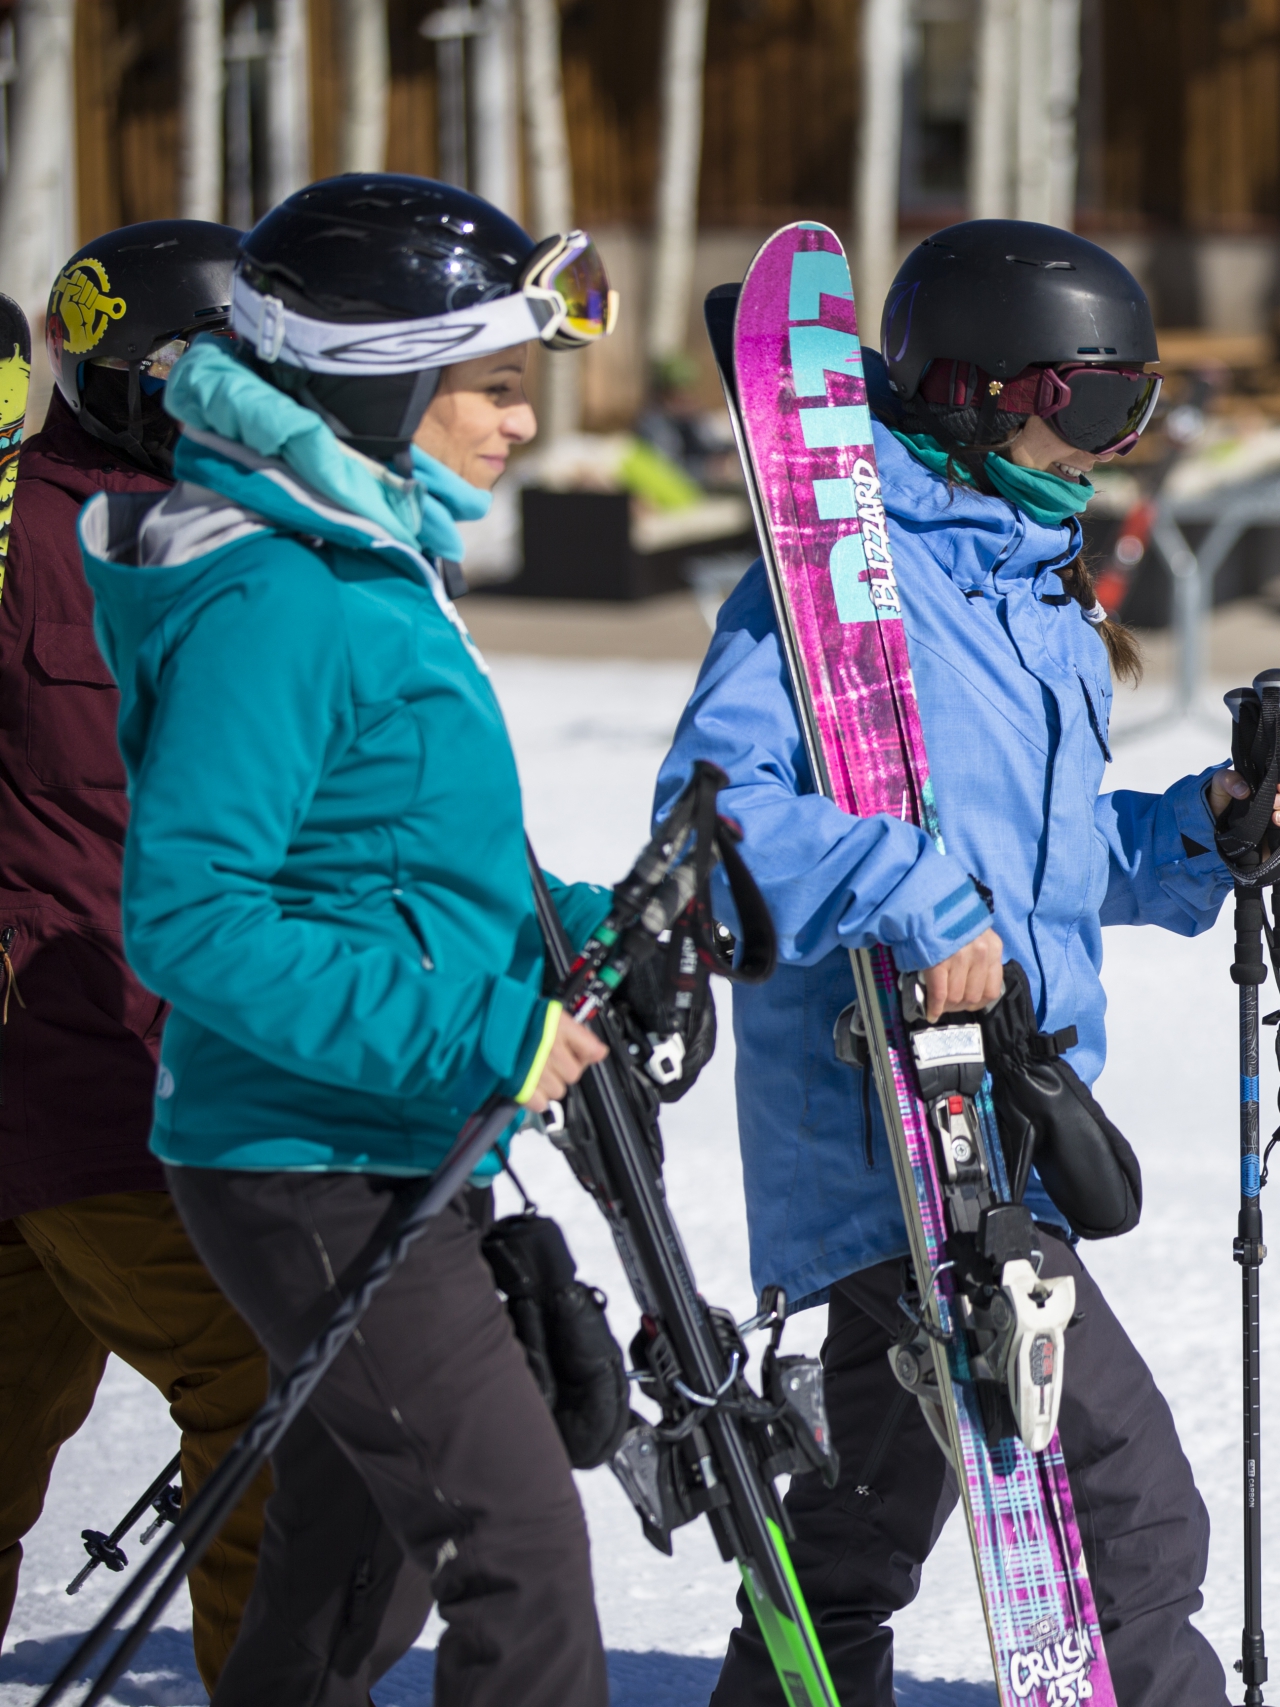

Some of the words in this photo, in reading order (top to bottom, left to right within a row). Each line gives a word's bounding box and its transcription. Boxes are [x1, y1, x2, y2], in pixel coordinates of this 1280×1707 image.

[851, 456, 902, 614] BLIZZARD
[1010, 1623, 1096, 1698] CRUSH
[1046, 1667, 1093, 1707] 156
